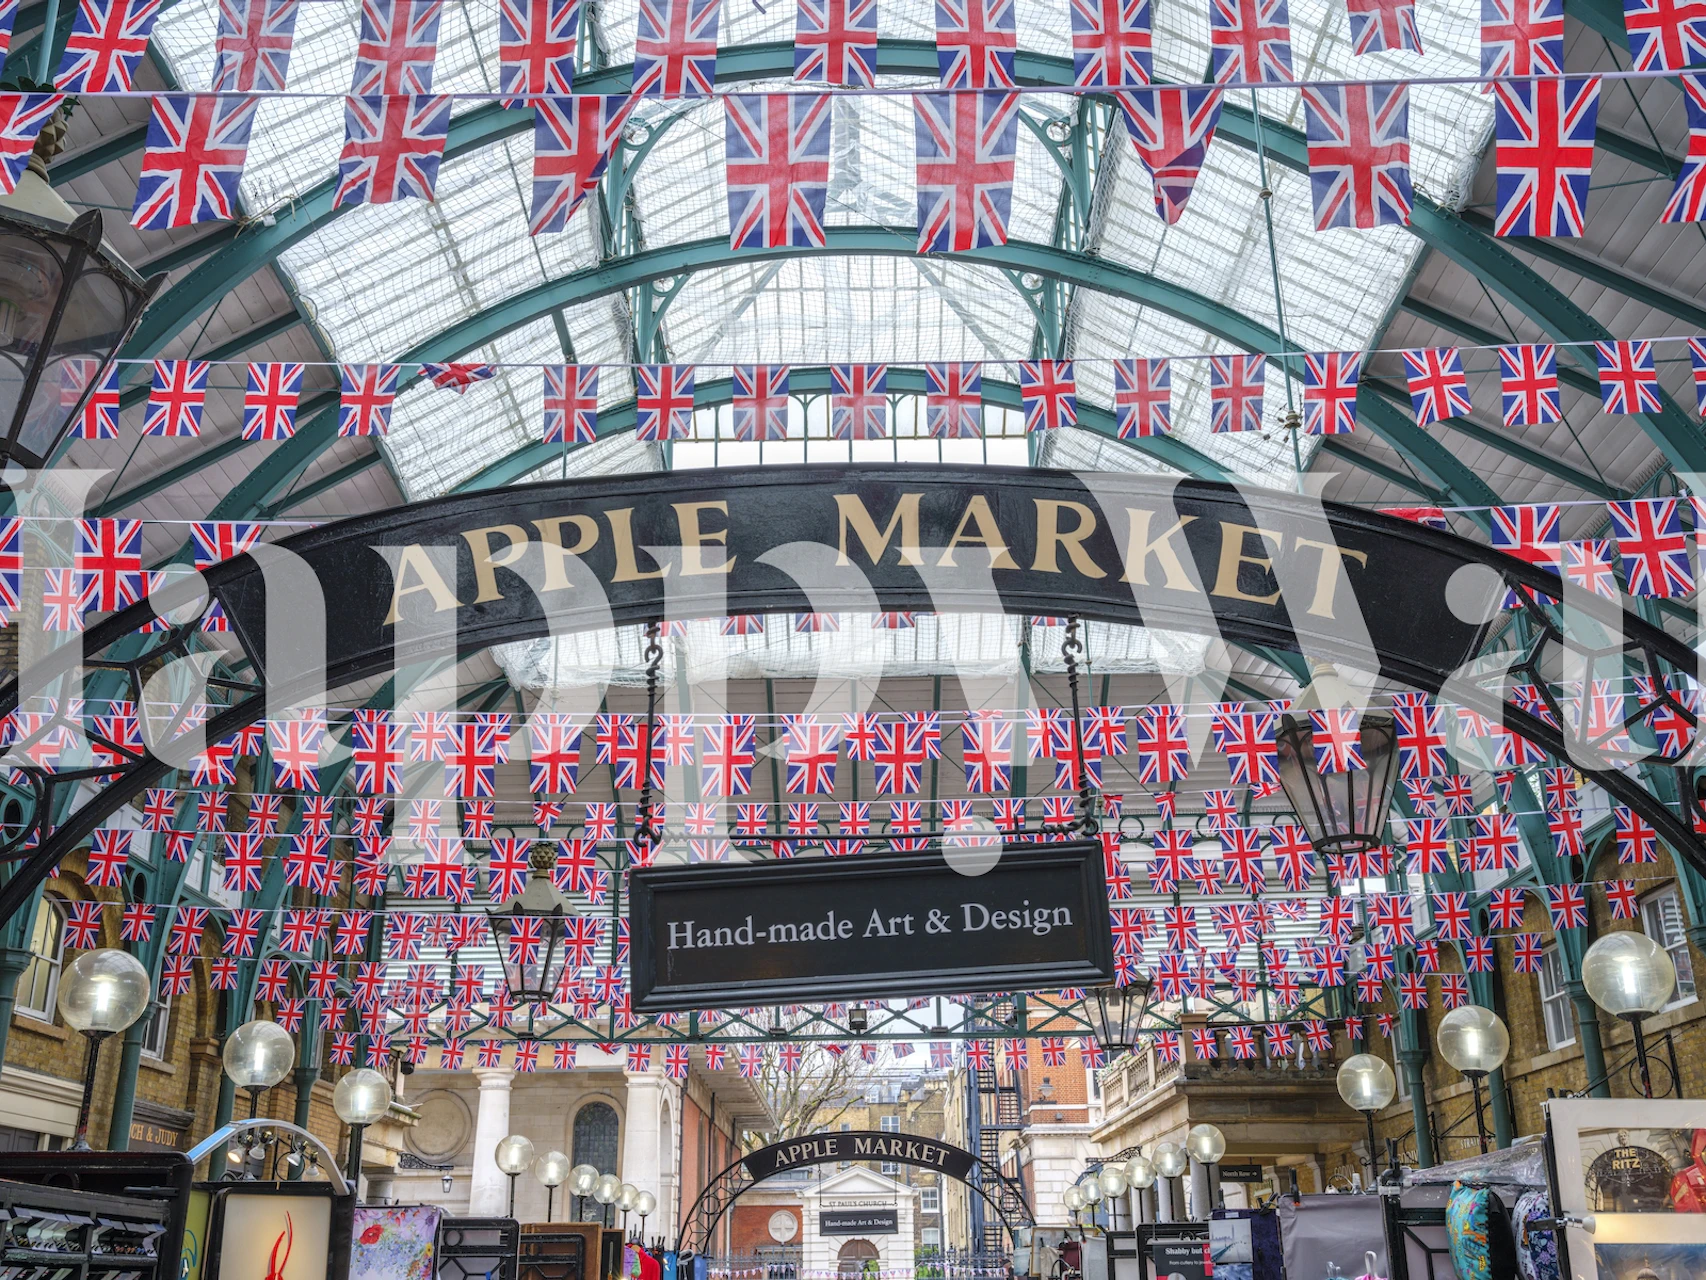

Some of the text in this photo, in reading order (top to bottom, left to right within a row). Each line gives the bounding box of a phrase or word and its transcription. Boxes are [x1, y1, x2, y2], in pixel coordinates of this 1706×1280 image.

[382, 493, 1368, 626] APPLE MARKET
[667, 900, 1074, 951] Hand-made Art & Design
[146, 1126, 153, 1143] &
[155, 1128, 178, 1147] JUDY
[775, 1137, 950, 1168] APPLE MARKET
[1614, 1148, 1638, 1158] THE
[1612, 1158, 1641, 1170] RITZ
[1165, 1247, 1190, 1256] Shabby
[1191, 1247, 1203, 1255] but
